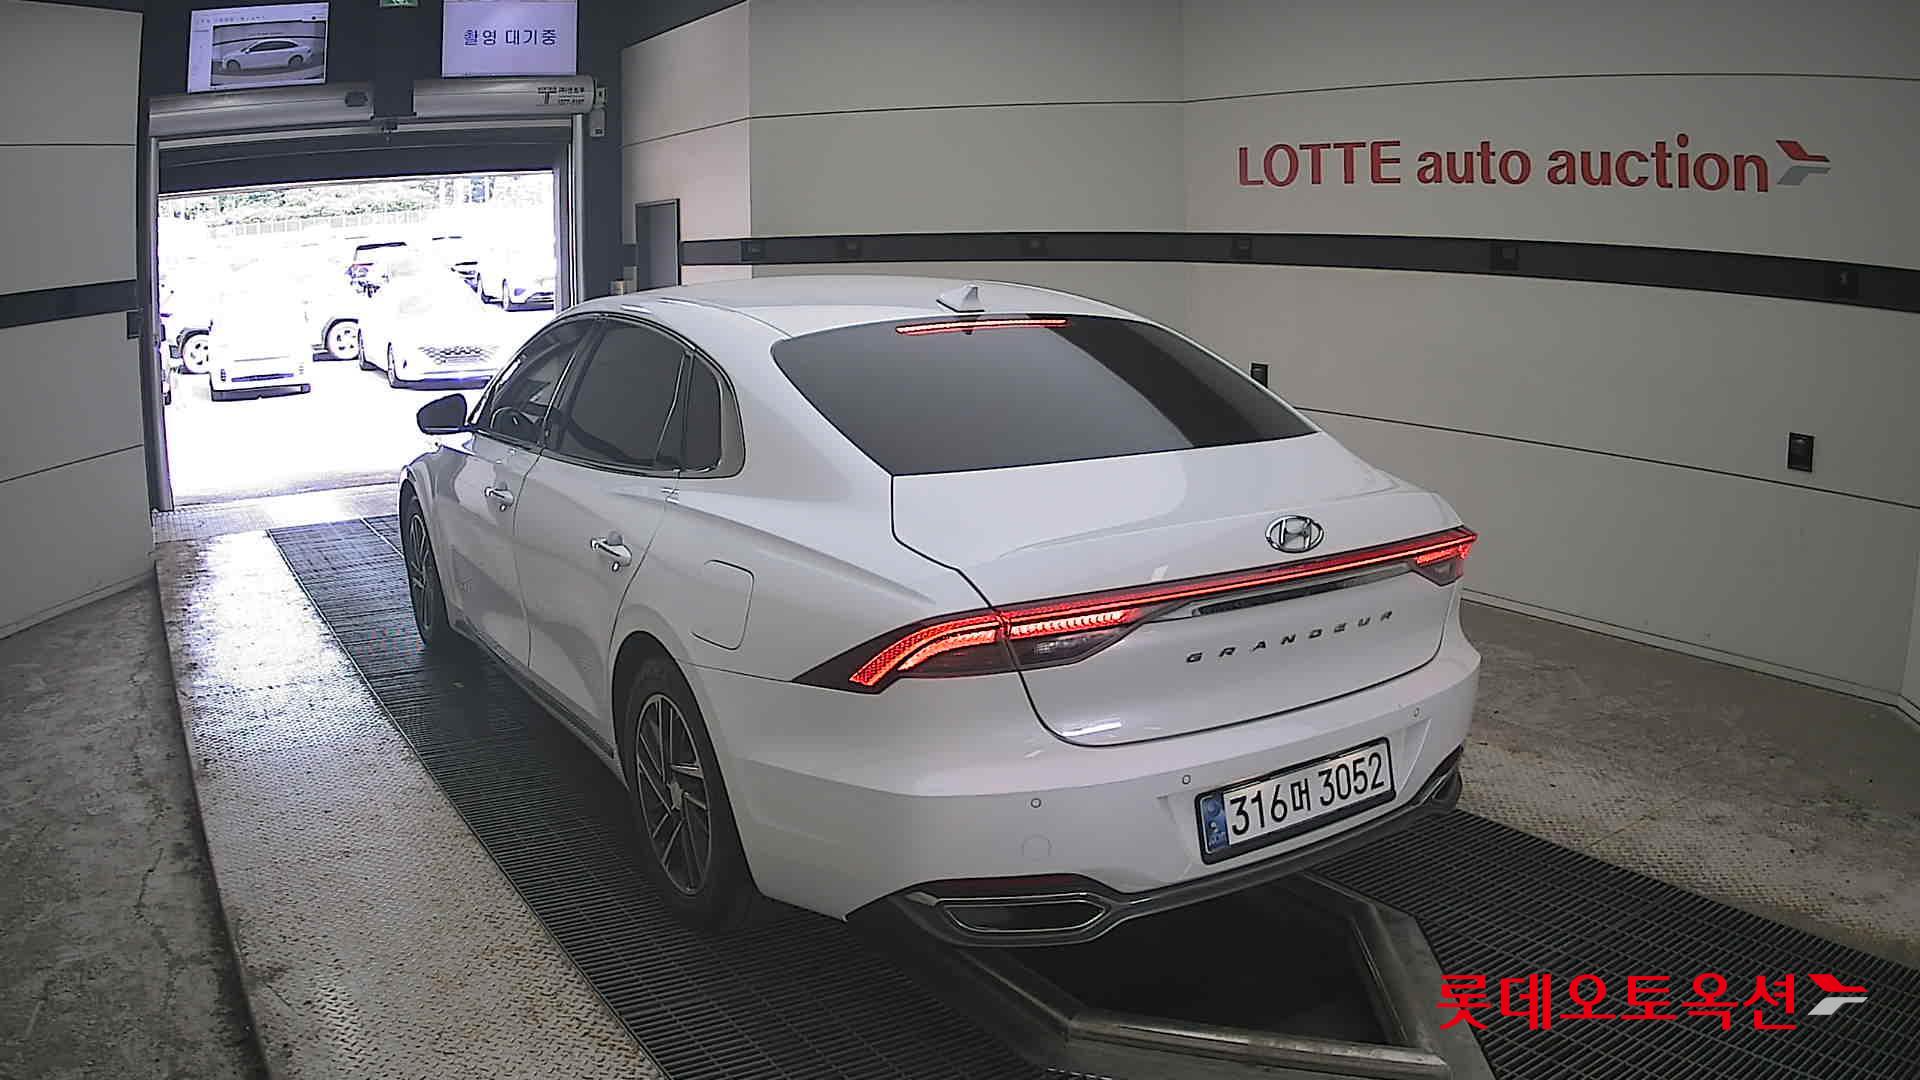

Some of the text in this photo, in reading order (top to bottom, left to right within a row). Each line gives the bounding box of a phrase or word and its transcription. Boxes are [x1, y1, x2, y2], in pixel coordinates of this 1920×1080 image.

[504, 29, 558, 46] 대기중
[1238, 133, 1770, 193] LOTTE auto auction
[1186, 610, 1393, 663] GRANDEUR
[1318, 751, 1385, 806] 3052
